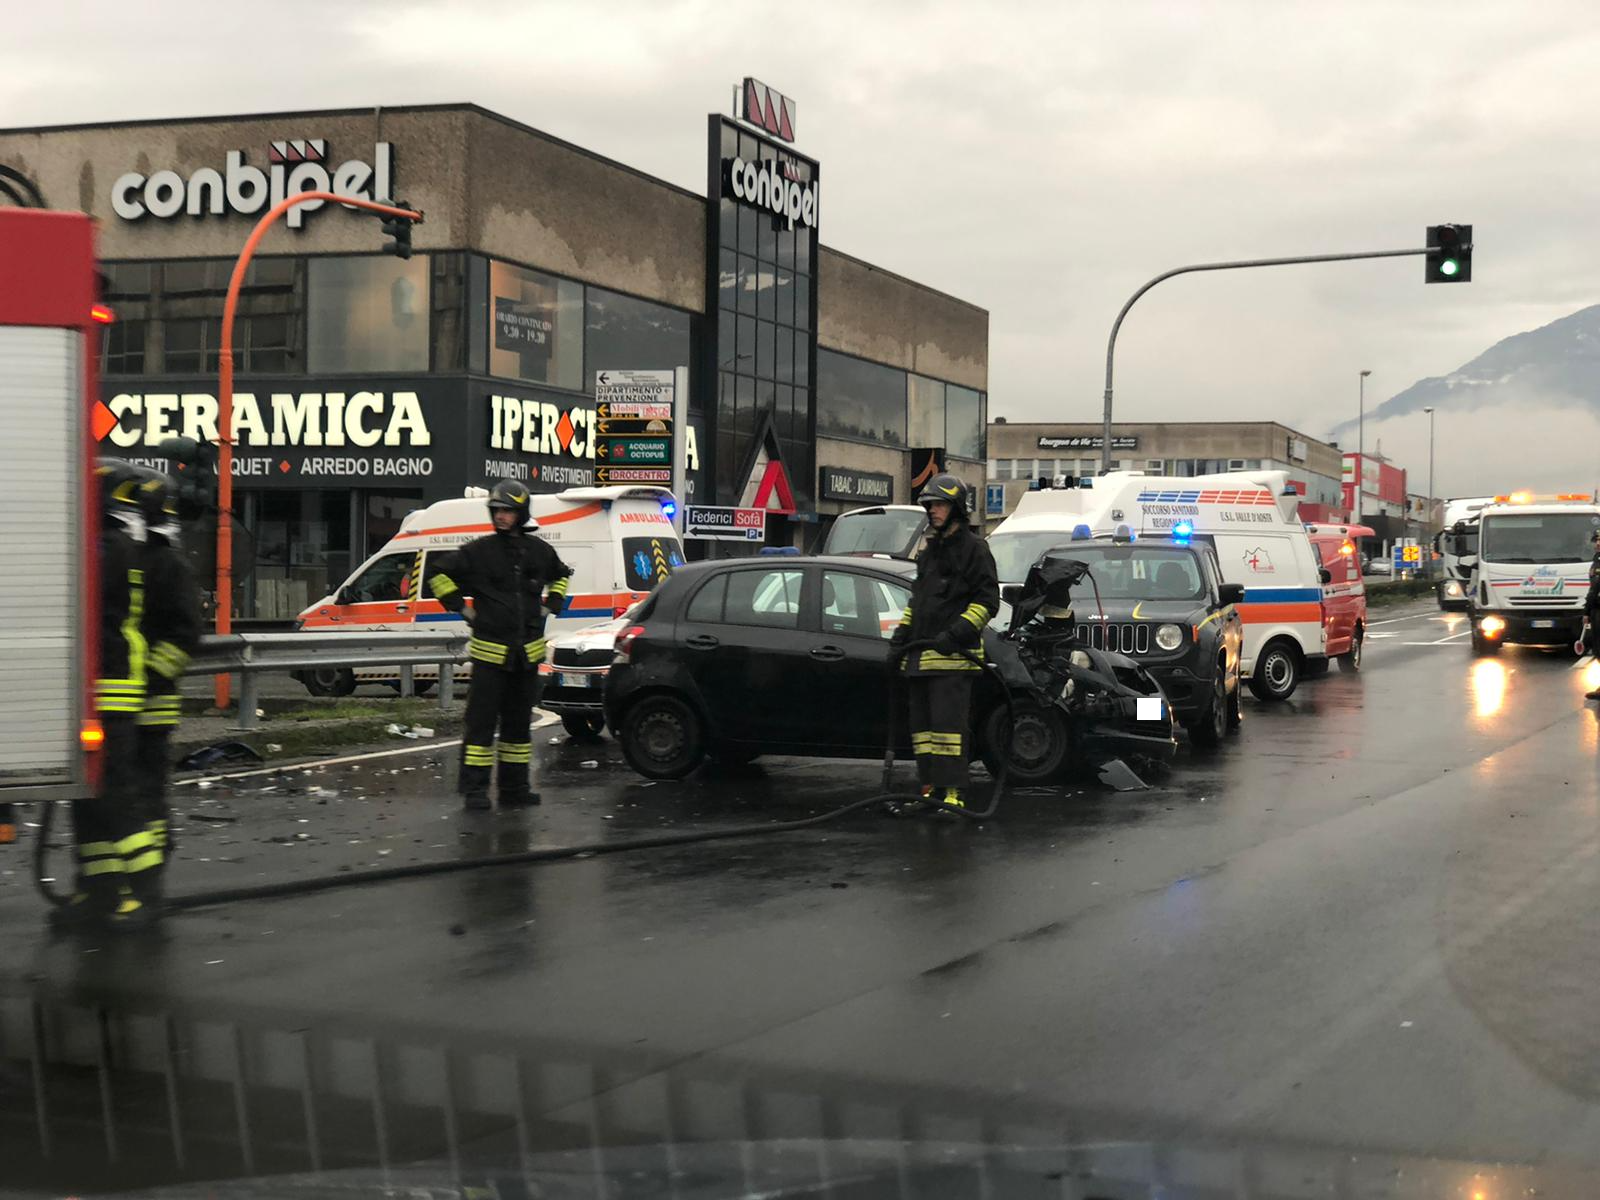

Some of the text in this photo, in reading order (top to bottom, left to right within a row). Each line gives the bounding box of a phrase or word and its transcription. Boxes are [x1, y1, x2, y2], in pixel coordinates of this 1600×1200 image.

[111, 139, 391, 228] conbipel
[731, 157, 818, 231] conbipel
[597, 386, 662, 394] DIPARTIMENTO
[597, 394, 658, 402] PREVENZIONE
[108, 391, 431, 447] CERAMICA
[300, 457, 370, 475] ARREDO
[373, 457, 433, 476] BAGNO
[485, 459, 592, 485] PAVIMENTI RIVESTIMENTI
[609, 471, 669, 480] IDROCENTRO
[830, 474, 889, 498] TABAC JOURNAUX
[691, 508, 761, 526] Federici Sofà
[1142, 504, 1200, 515] SOCCORSO SANITARIO
[1235, 512, 1252, 522] VALLE
